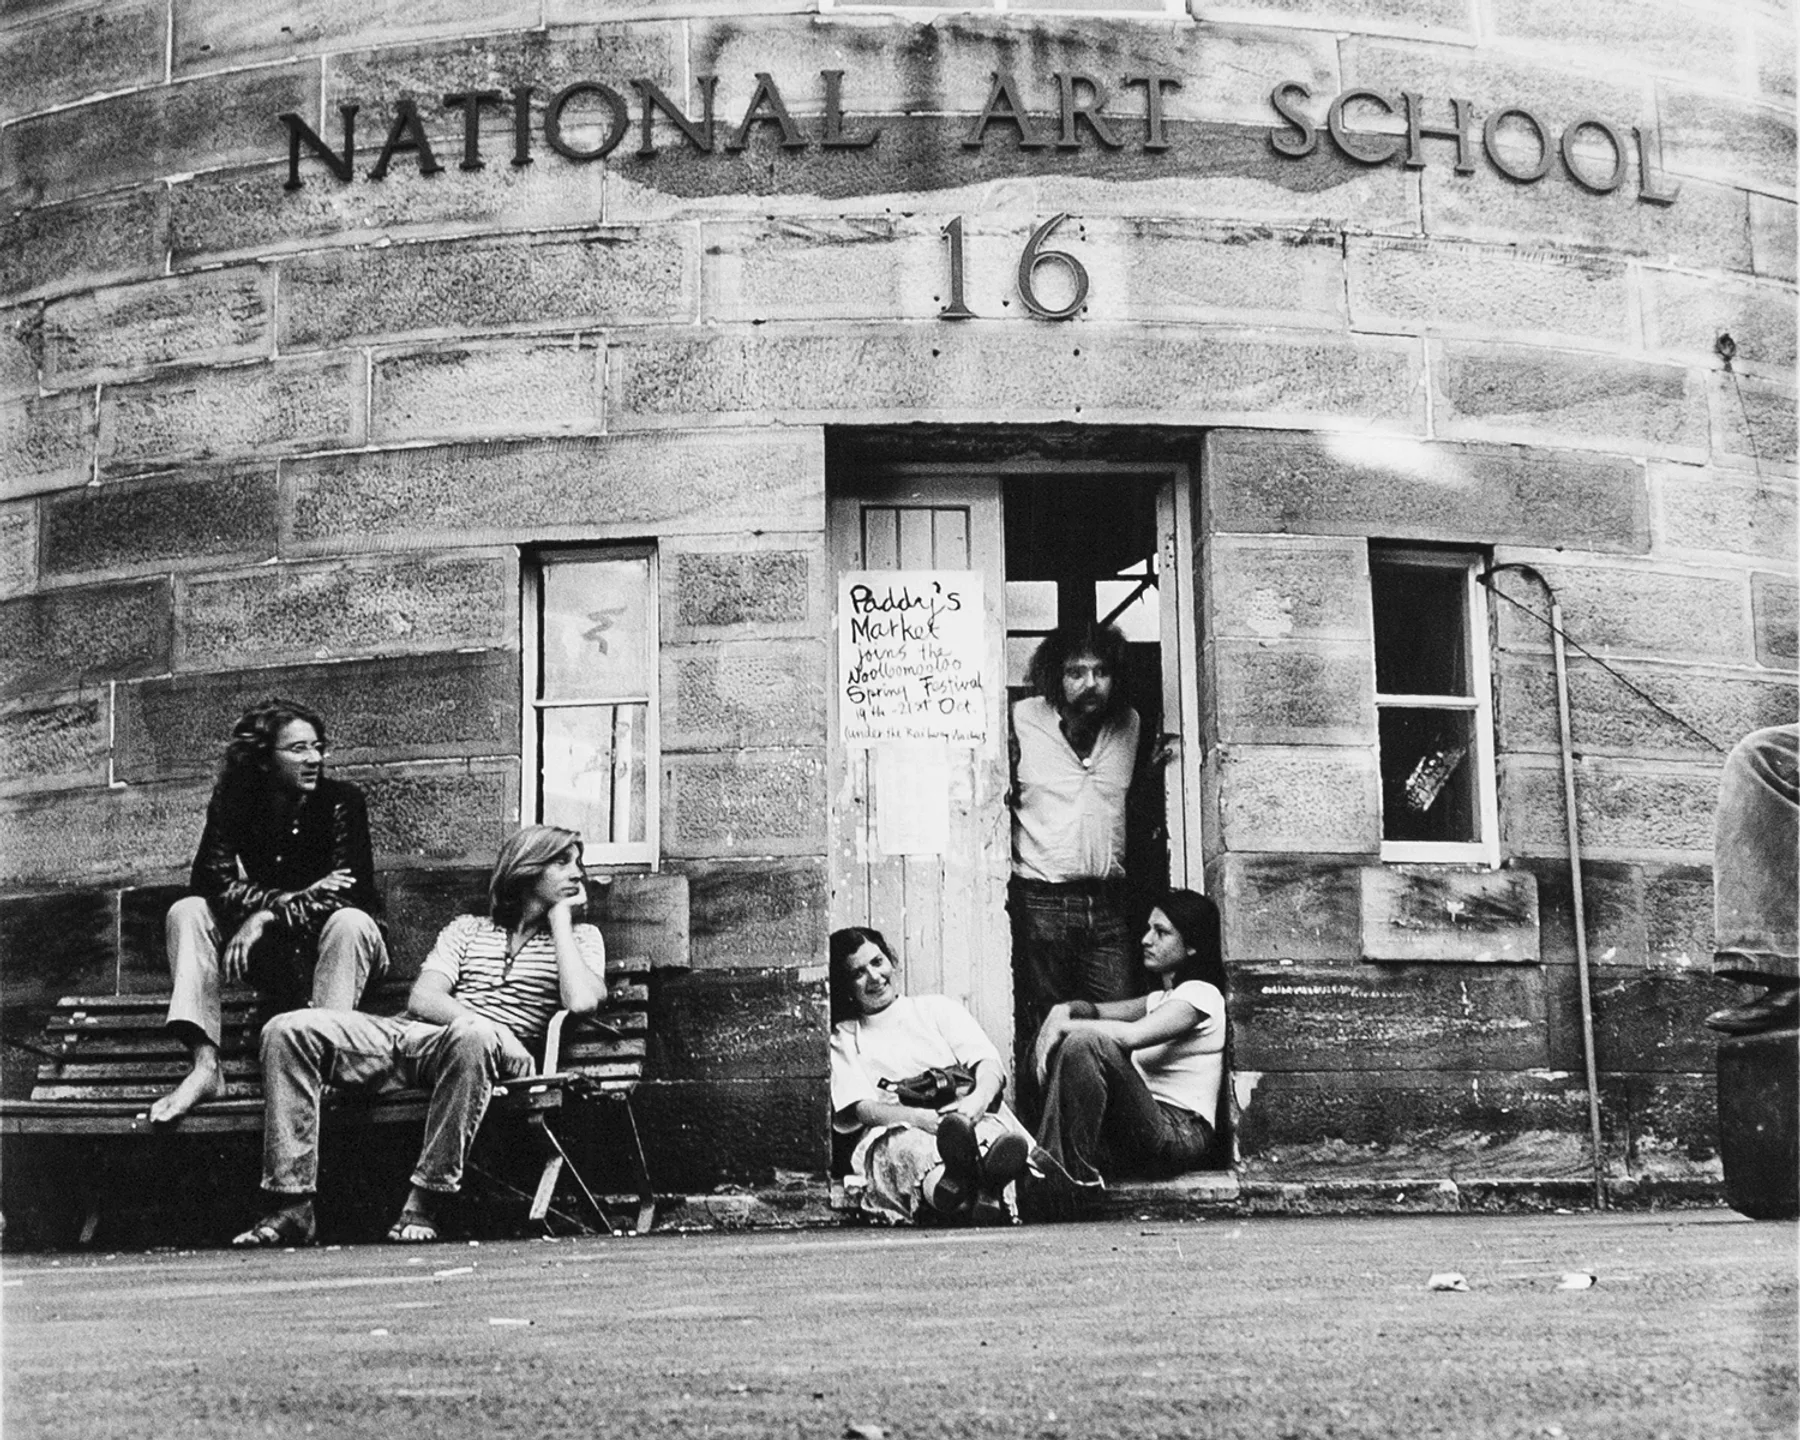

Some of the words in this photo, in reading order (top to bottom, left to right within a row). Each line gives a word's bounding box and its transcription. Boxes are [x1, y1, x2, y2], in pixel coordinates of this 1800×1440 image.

[279, 69, 880, 190] NATIONAL
[962, 71, 1182, 151] ART
[1268, 80, 1681, 206] SCHOOL
[939, 212, 1090, 321] 16
[850, 581, 961, 625] Paddy's
[851, 613, 940, 643] Market
[858, 642, 907, 669] joins
[919, 643, 951, 662] the
[847, 684, 908, 705] Spring
[919, 671, 983, 697] Festival
